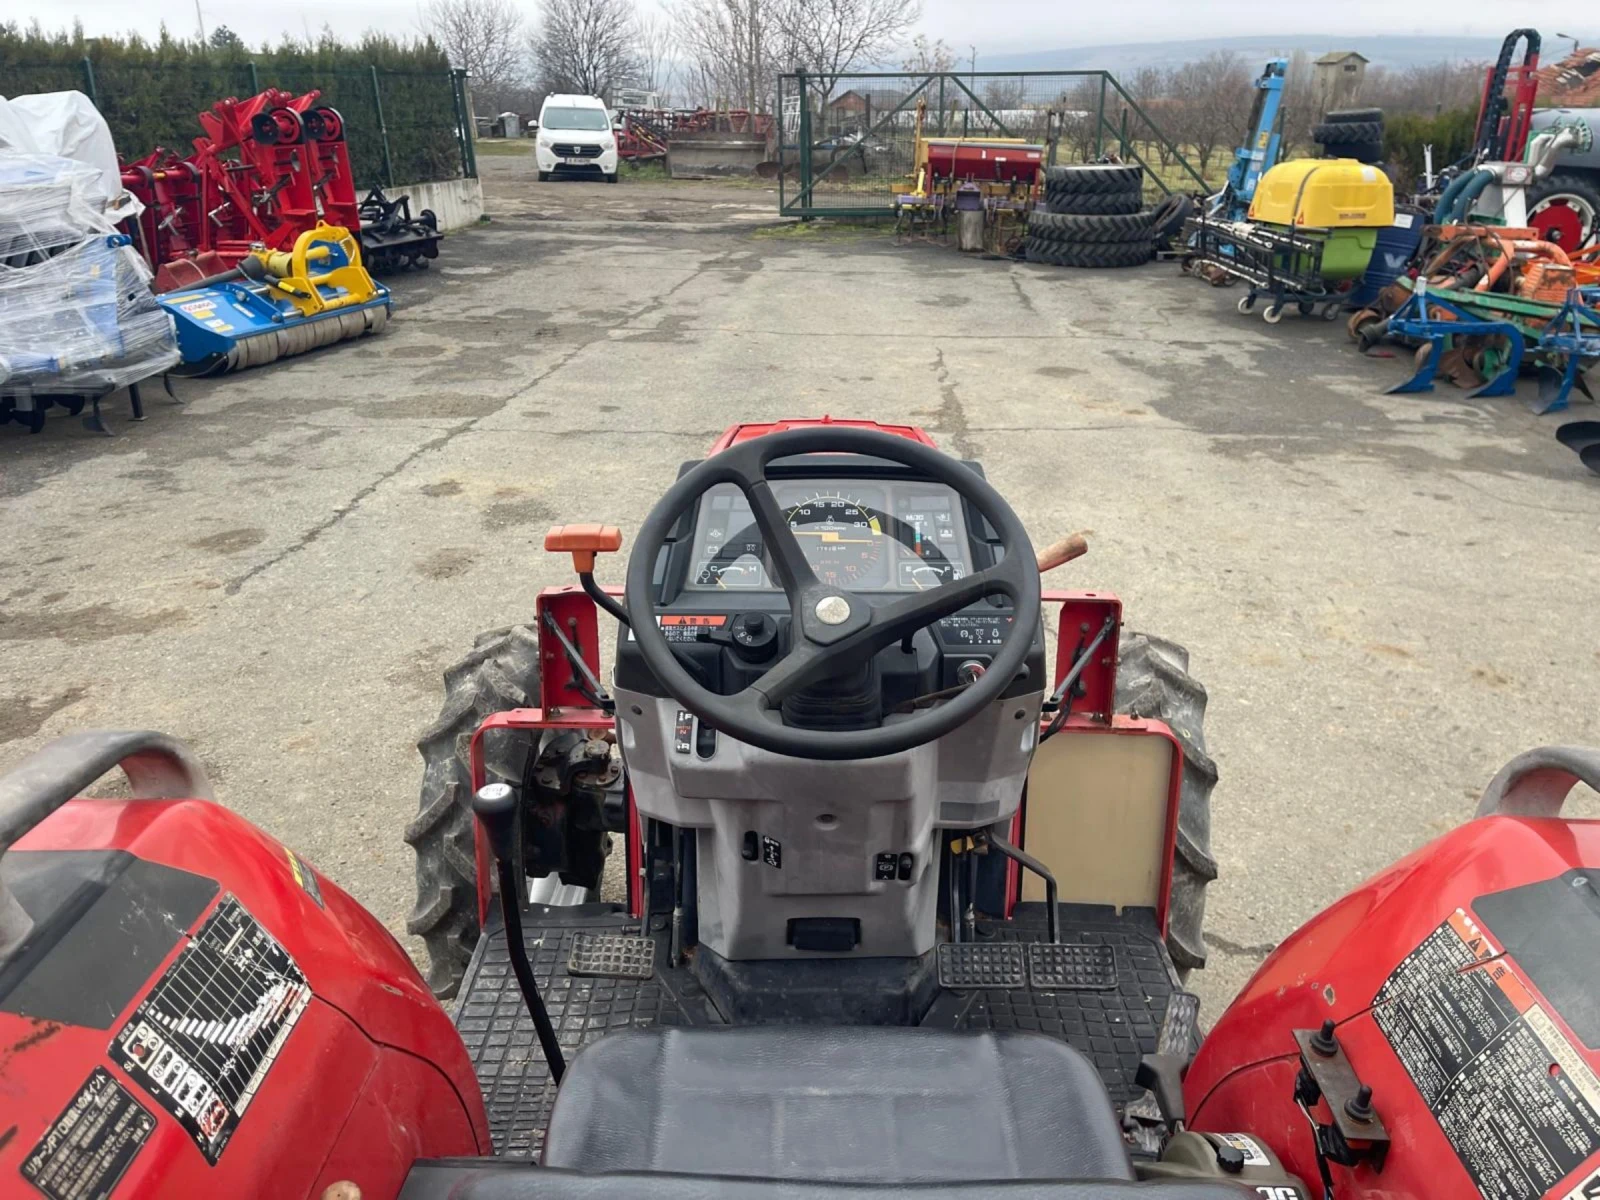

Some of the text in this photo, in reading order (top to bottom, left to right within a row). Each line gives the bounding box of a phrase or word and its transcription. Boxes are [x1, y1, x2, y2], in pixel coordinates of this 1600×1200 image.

[123, 1059, 135, 1072] SL
[150, 1085, 159, 1094] L
[174, 1106, 185, 1118] M
[195, 1131, 205, 1142] H
